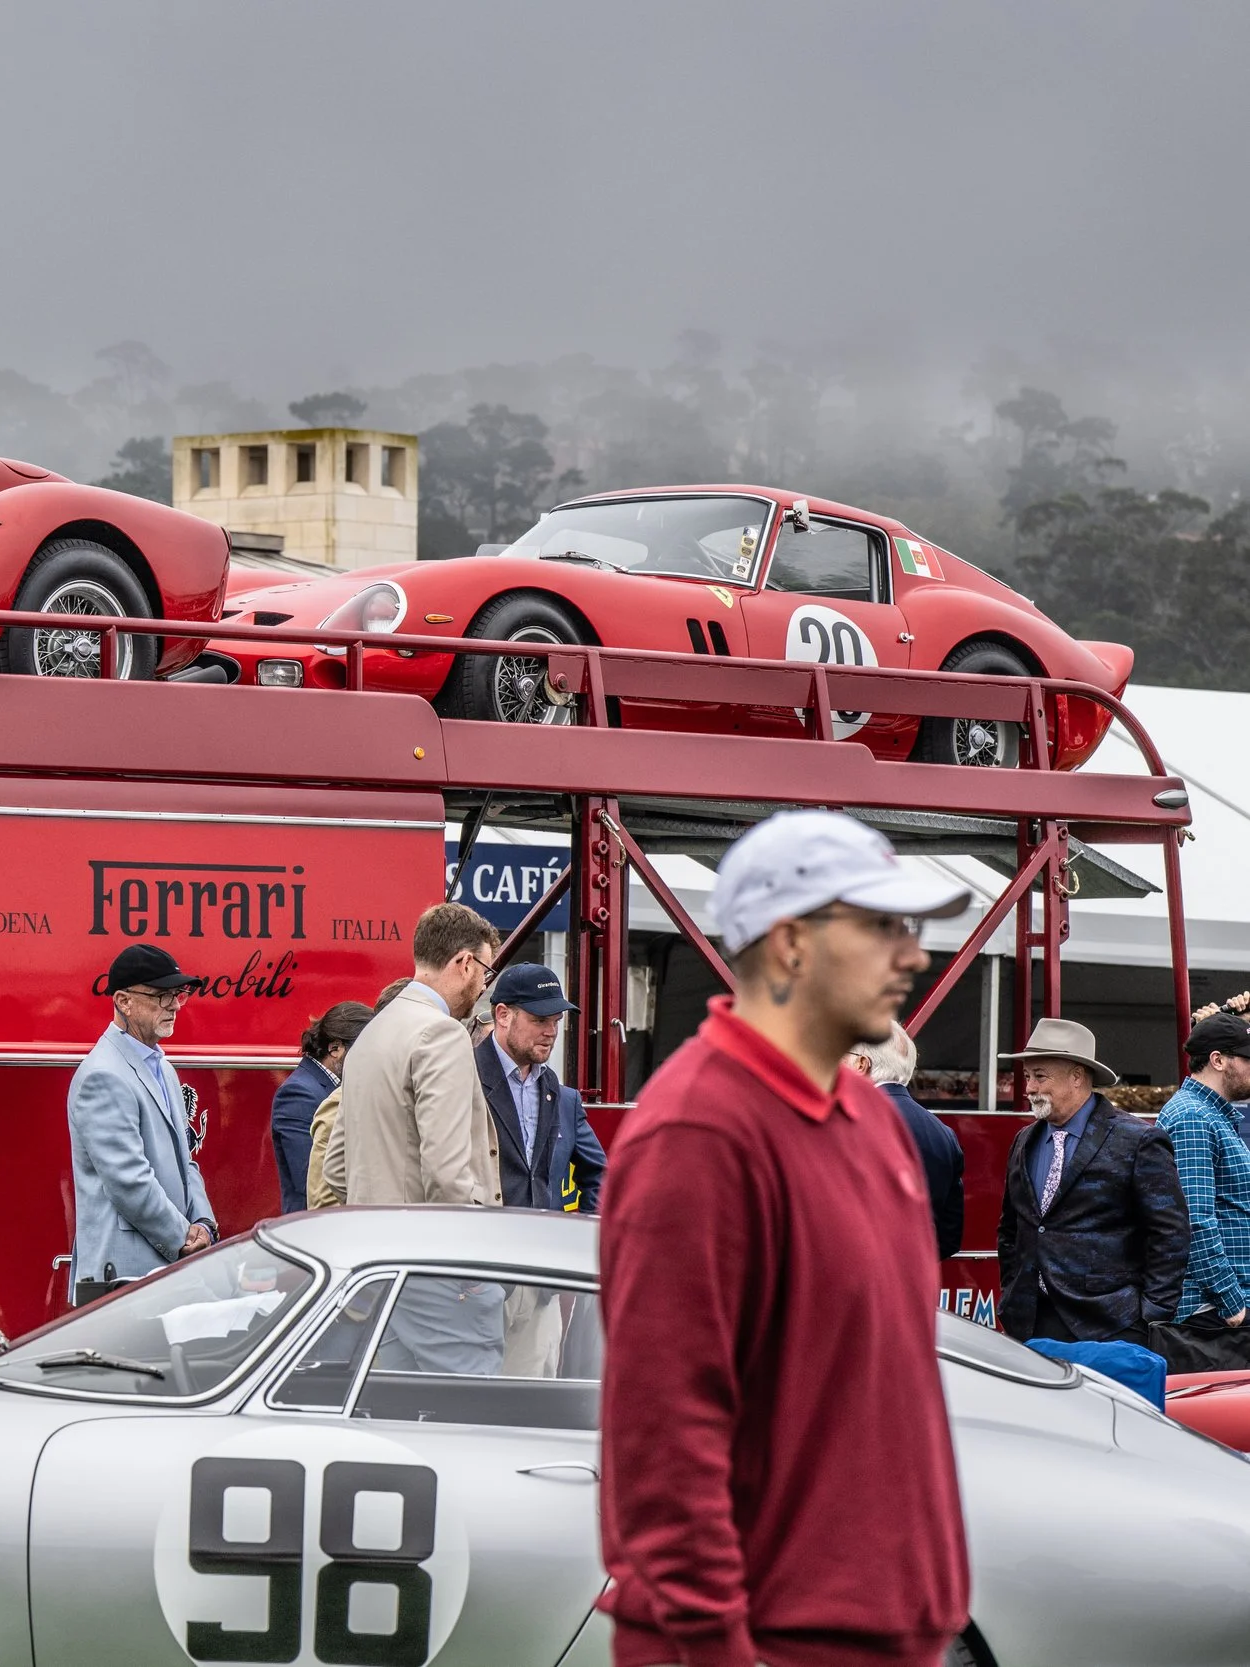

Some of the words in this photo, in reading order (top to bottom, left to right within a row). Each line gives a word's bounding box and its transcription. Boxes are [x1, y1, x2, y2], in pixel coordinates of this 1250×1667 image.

[88, 860, 306, 939] Ferrari
[332, 918, 402, 941] ITALIA
[186, 1456, 438, 1667] 98
